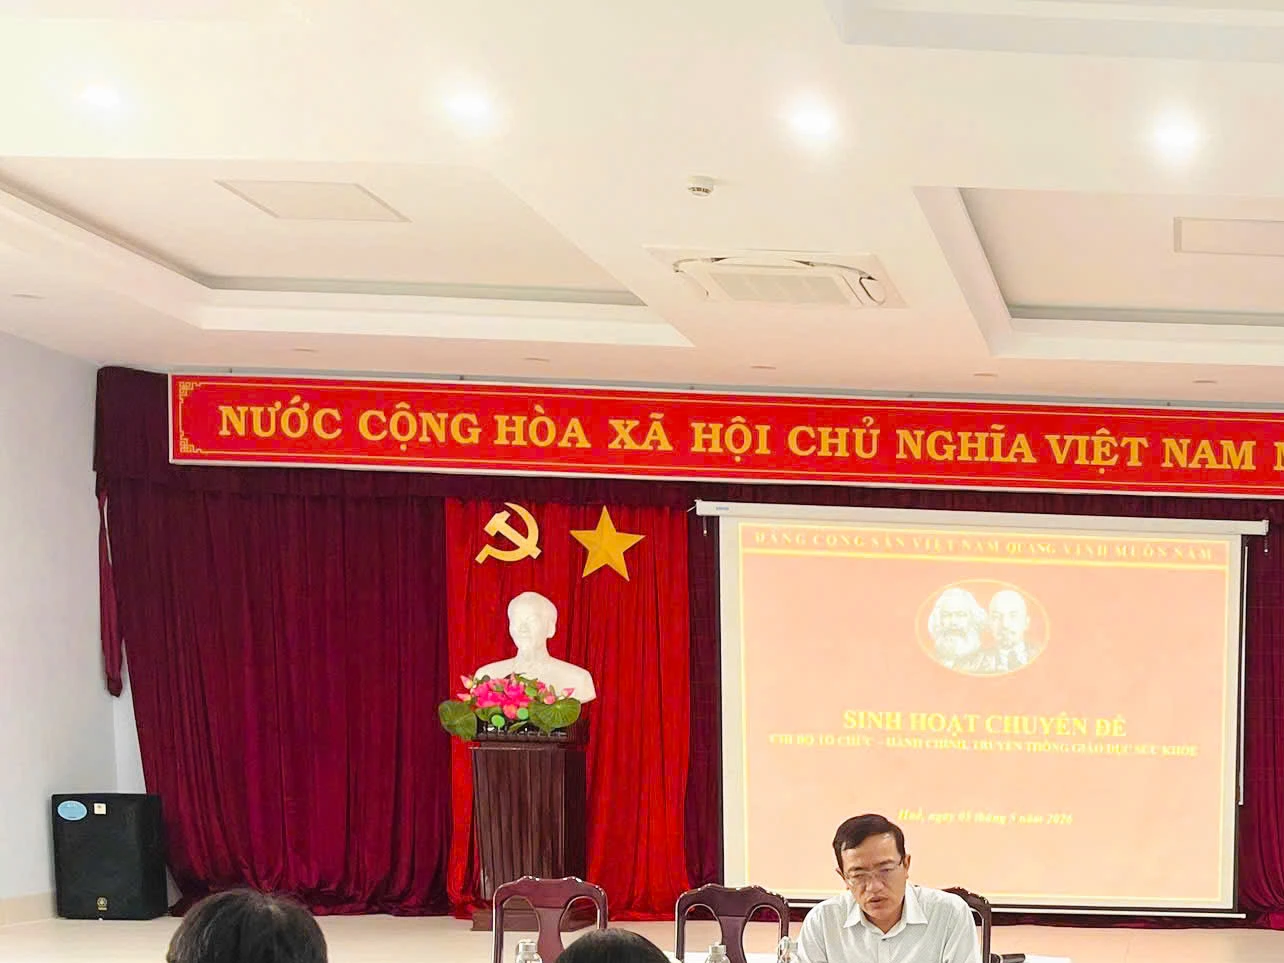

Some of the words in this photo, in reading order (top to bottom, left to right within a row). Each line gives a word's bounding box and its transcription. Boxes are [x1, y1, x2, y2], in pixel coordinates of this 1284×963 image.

[218, 394, 342, 440] NƯỚC
[358, 401, 482, 452] CỘNG
[493, 404, 592, 449] HÒA
[607, 412, 674, 451] XÃ
[690, 415, 771, 463] HỘI
[787, 415, 881, 459] CHỦ
[895, 423, 1037, 464] NGHĨA
[1044, 427, 1149, 475] VIỆT
[1161, 437, 1257, 471] NAM
[960, 538, 1000, 554] NAM
[1006, 541, 1057, 557] QUANG
[1063, 542, 1108, 557] VINH
[842, 709, 902, 730] SINH
[909, 712, 980, 736] HOẠT
[984, 711, 1089, 737] CHUYÊN
